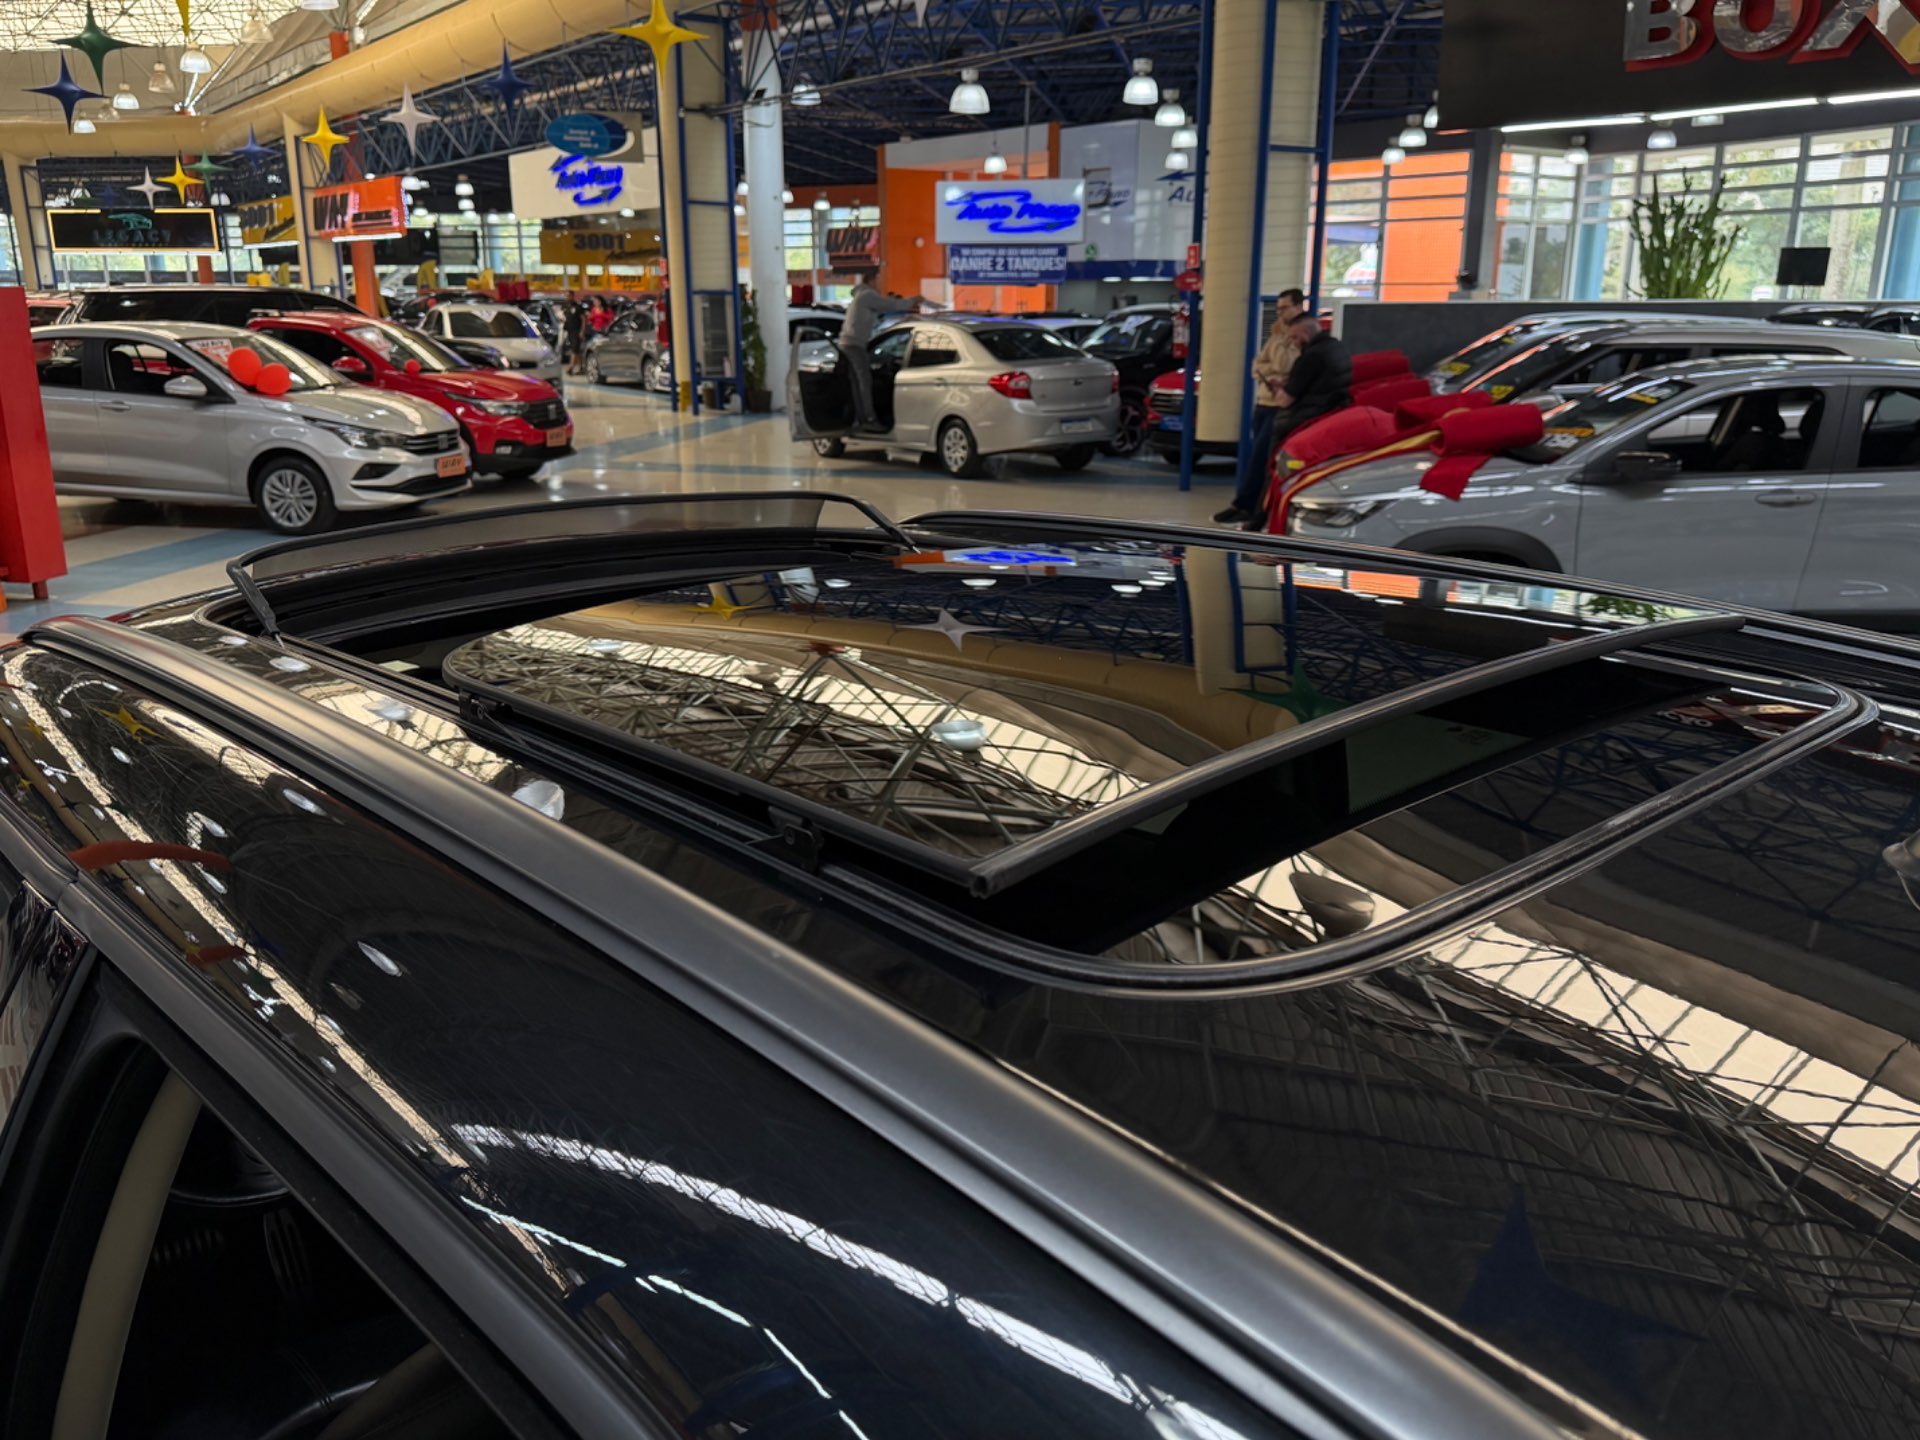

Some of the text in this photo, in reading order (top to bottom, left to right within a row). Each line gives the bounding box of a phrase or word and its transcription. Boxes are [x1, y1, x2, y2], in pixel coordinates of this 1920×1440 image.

[573, 233, 625, 250] 3001
[951, 256, 994, 271] GANHE
[995, 257, 1005, 271] 2
